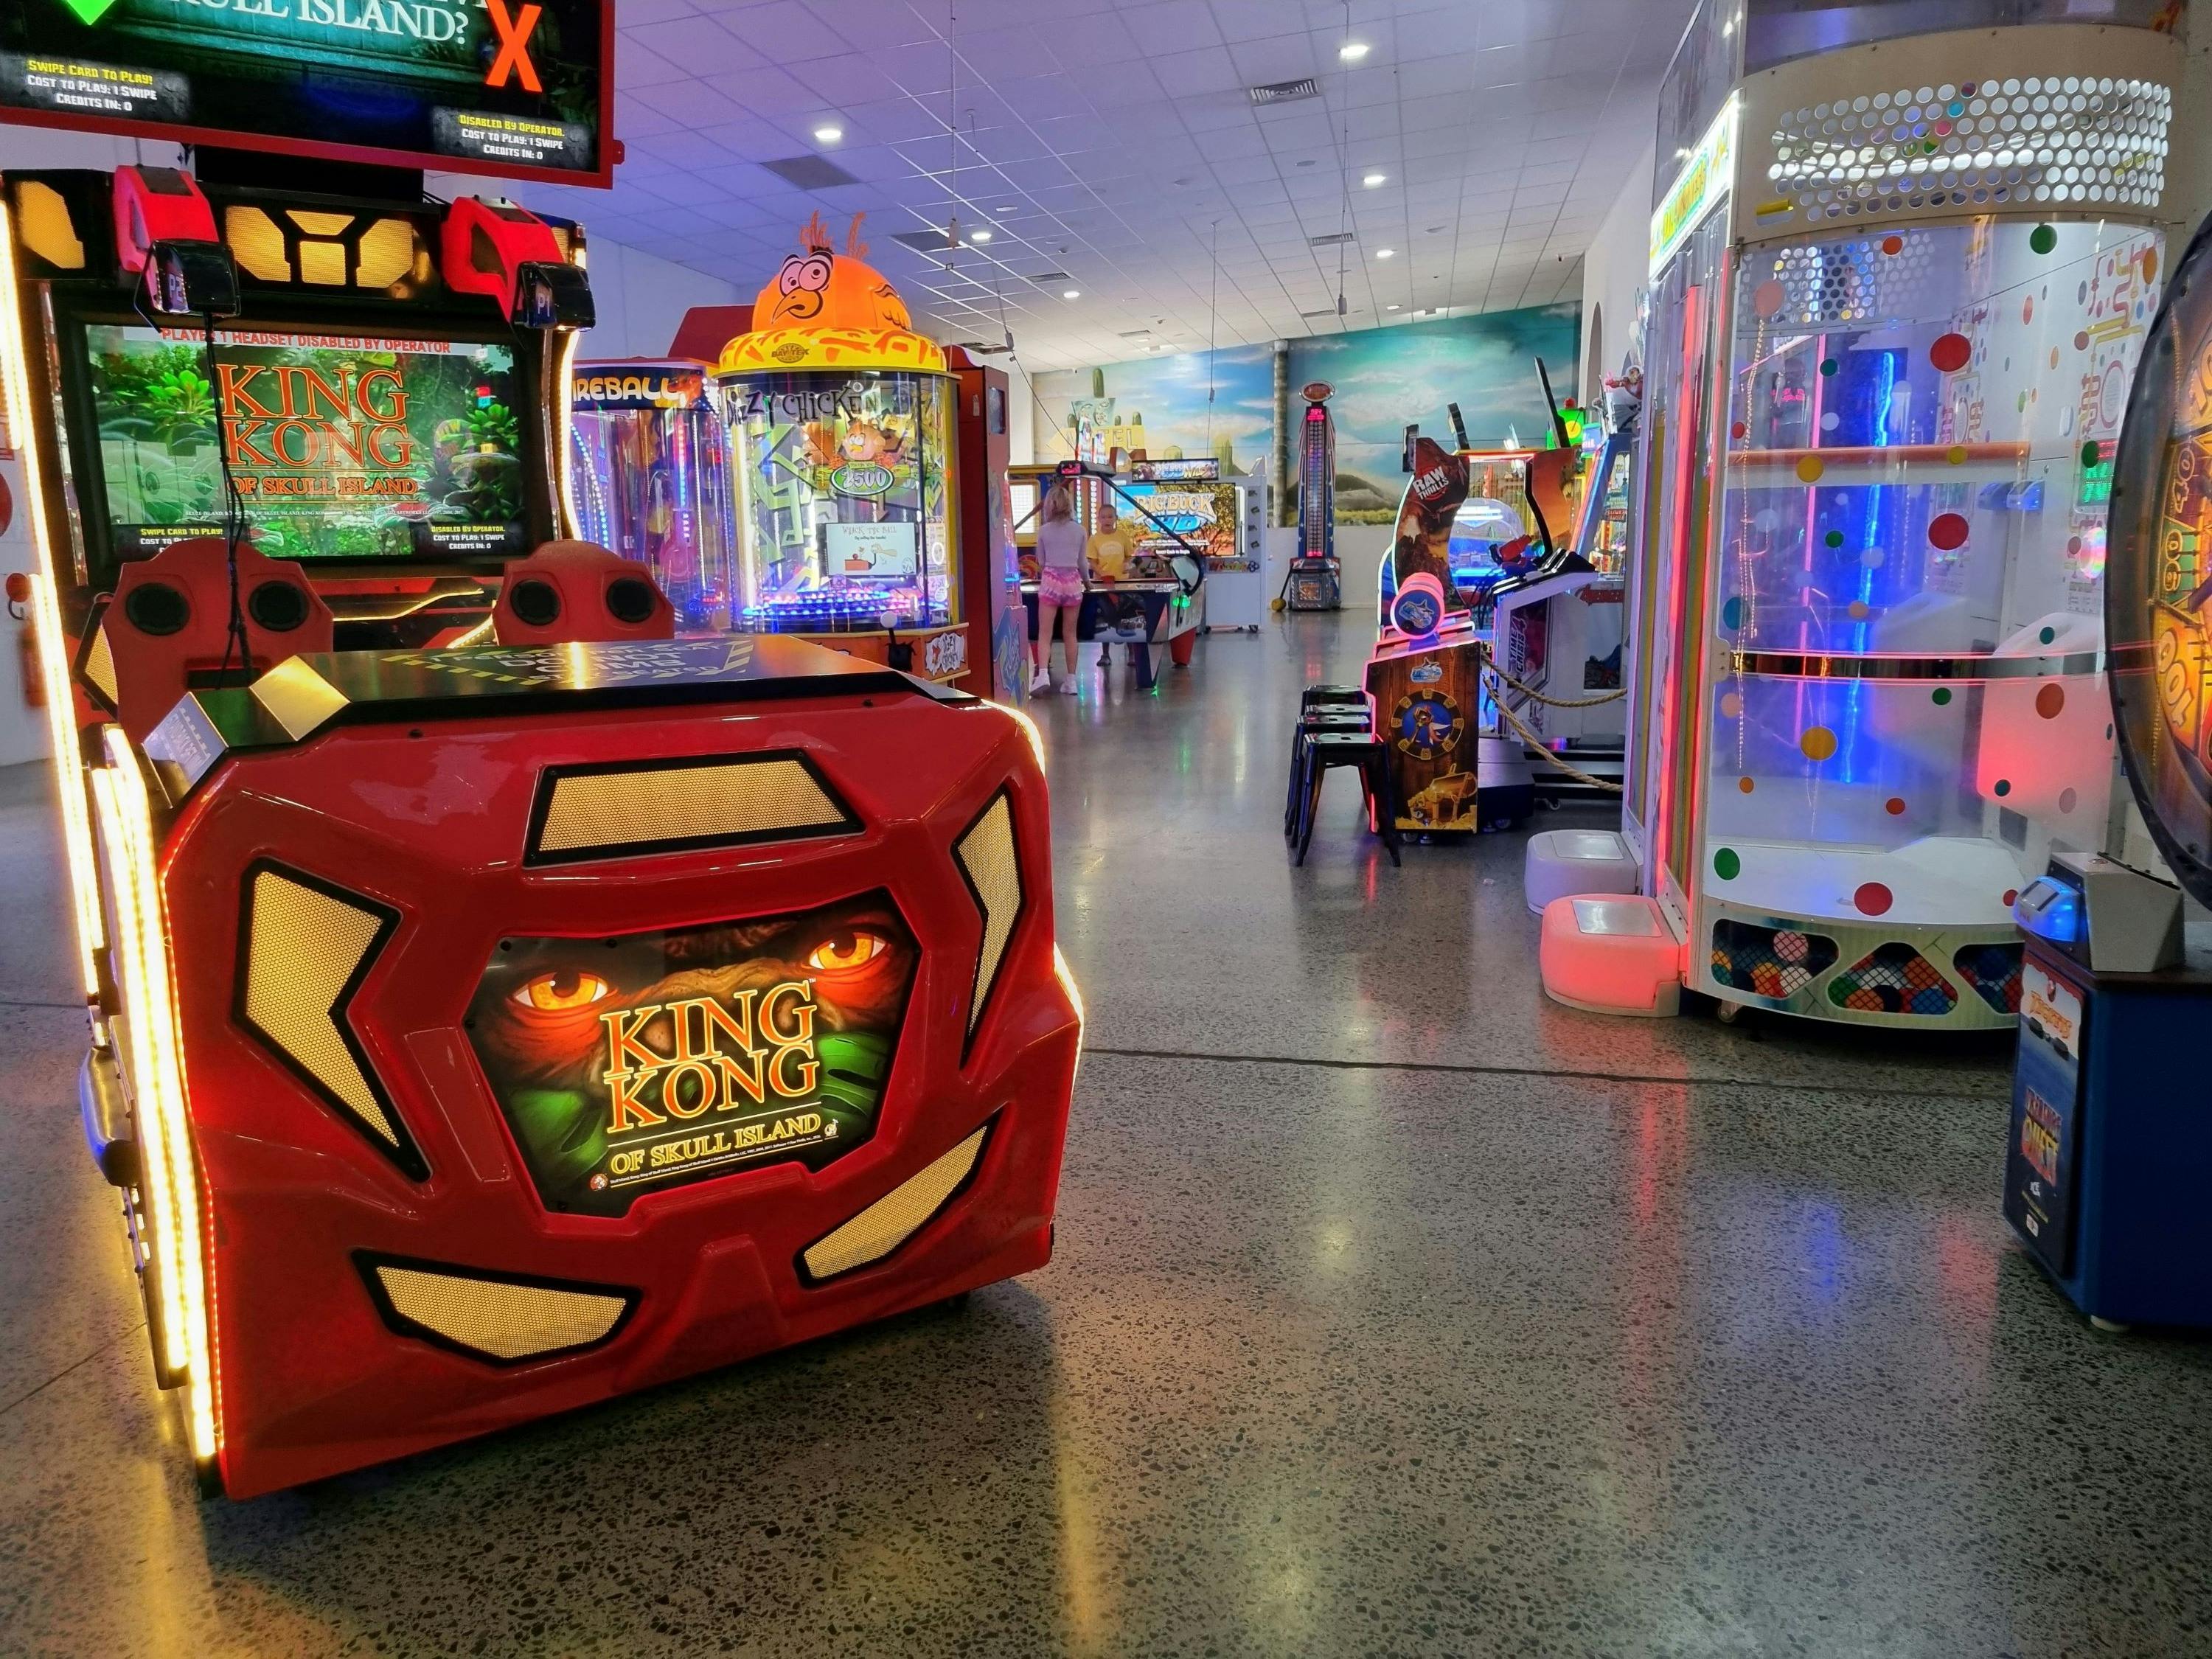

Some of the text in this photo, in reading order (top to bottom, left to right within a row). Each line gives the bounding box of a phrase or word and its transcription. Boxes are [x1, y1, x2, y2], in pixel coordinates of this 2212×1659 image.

[28, 60, 153, 85] SWIPE CARD TO PLAY!
[27, 75, 58, 88] COST
[62, 80, 74, 90] TO
[78, 80, 111, 95] PLAY:
[119, 86, 158, 100] SWIPE
[56, 94, 102, 108] CREDITS
[105, 99, 122, 111] IN:
[459, 114, 565, 137] DISABLED BY OPERATOR.
[462, 128, 485, 139] COST
[488, 133, 499, 142] TO
[502, 133, 527, 146] PLAY:
[535, 137, 563, 150] SWIPE
[483, 144, 520, 157] CREDITS
[538, 293, 550, 317] P1
[232, 332, 294, 346] HEADSET
[297, 335, 360, 349] DISABLED
[364, 338, 380, 351] BY
[383, 340, 451, 354] OPERATOR
[215, 364, 410, 422] KING
[573, 377, 681, 401] IREBALL
[223, 420, 415, 469] KONG
[262, 476, 337, 495] SKULL
[338, 476, 418, 495] ISLAND
[842, 469, 887, 489] 2500
[1412, 466, 1444, 493] RAW
[1418, 477, 1449, 500] THRILLS
[1167, 493, 1216, 518] BUCK
[1509, 629, 1517, 660] TIME
[1516, 633, 1526, 674] CRISIS
[498, 652, 682, 667] DO NOT
[535, 659, 686, 672] CIMB
[612, 666, 720, 675] SEATED
[2159, 630, 2194, 728] 100
[599, 978, 818, 1077] KING
[603, 1039, 821, 1135] KONG
[611, 1149, 645, 1175] OF
[650, 1132, 731, 1167] SKULL
[734, 1113, 821, 1149] ISLAND
